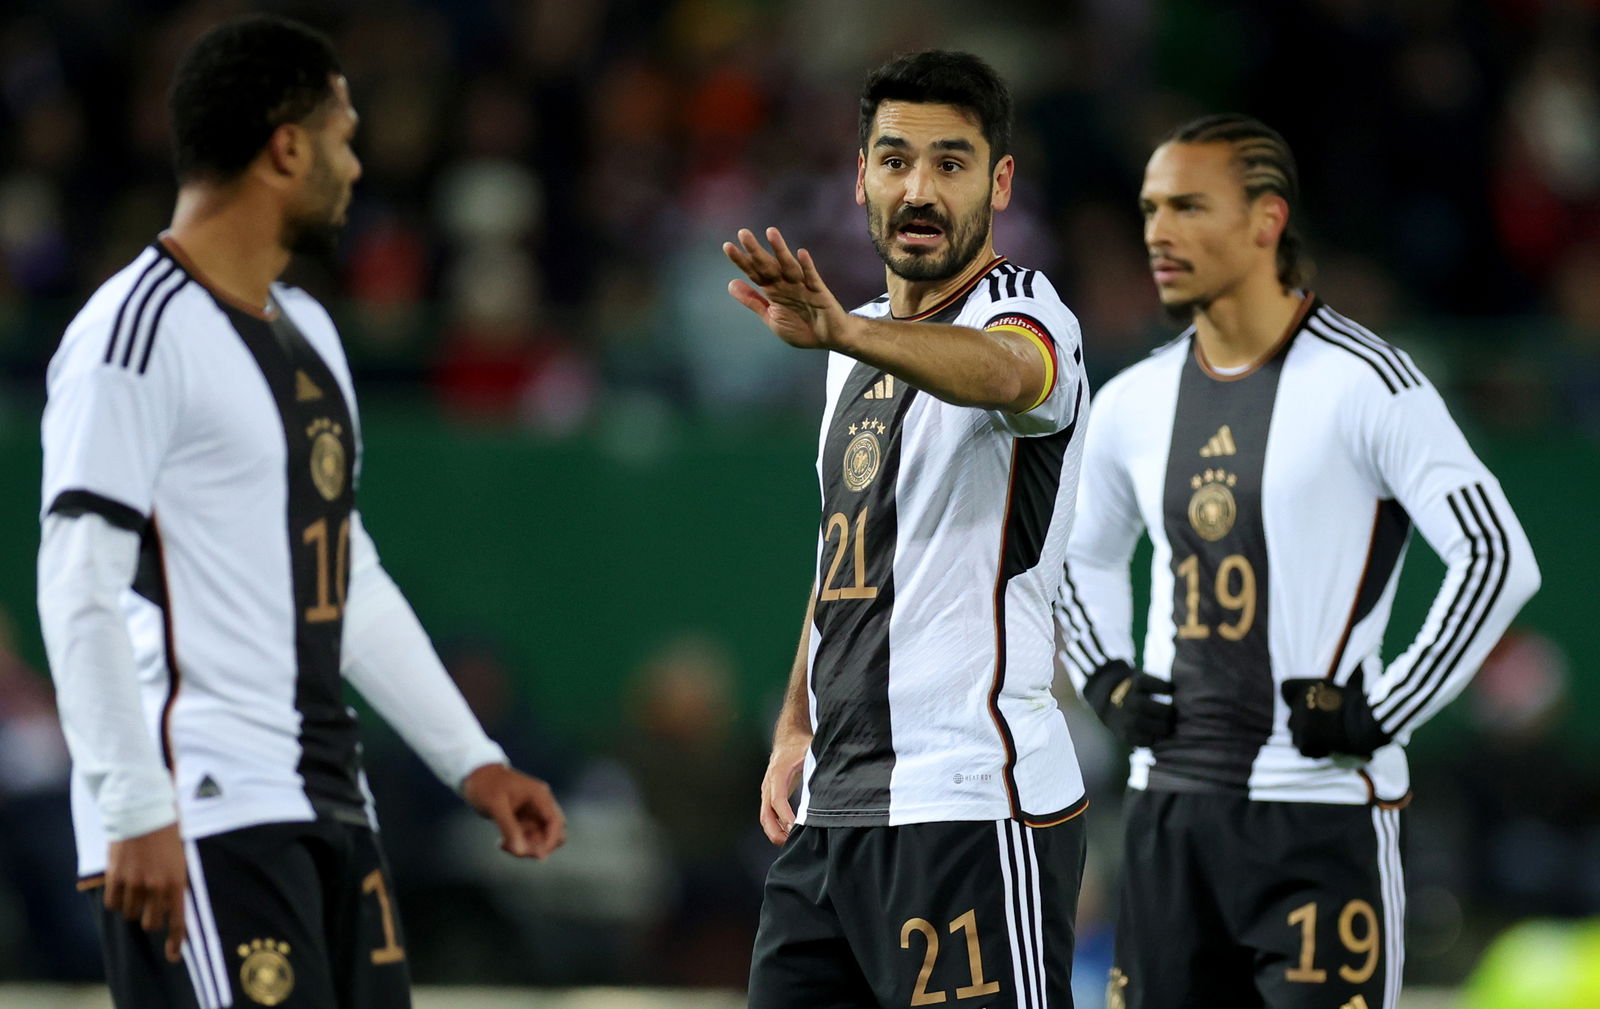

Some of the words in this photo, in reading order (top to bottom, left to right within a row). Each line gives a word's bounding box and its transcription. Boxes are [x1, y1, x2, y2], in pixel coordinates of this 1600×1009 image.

[983, 316, 1044, 337] ielführer
[821, 505, 878, 601] 21
[1177, 553, 1257, 640] 19
[900, 908, 1000, 1007] 21
[1285, 899, 1379, 984] 19
